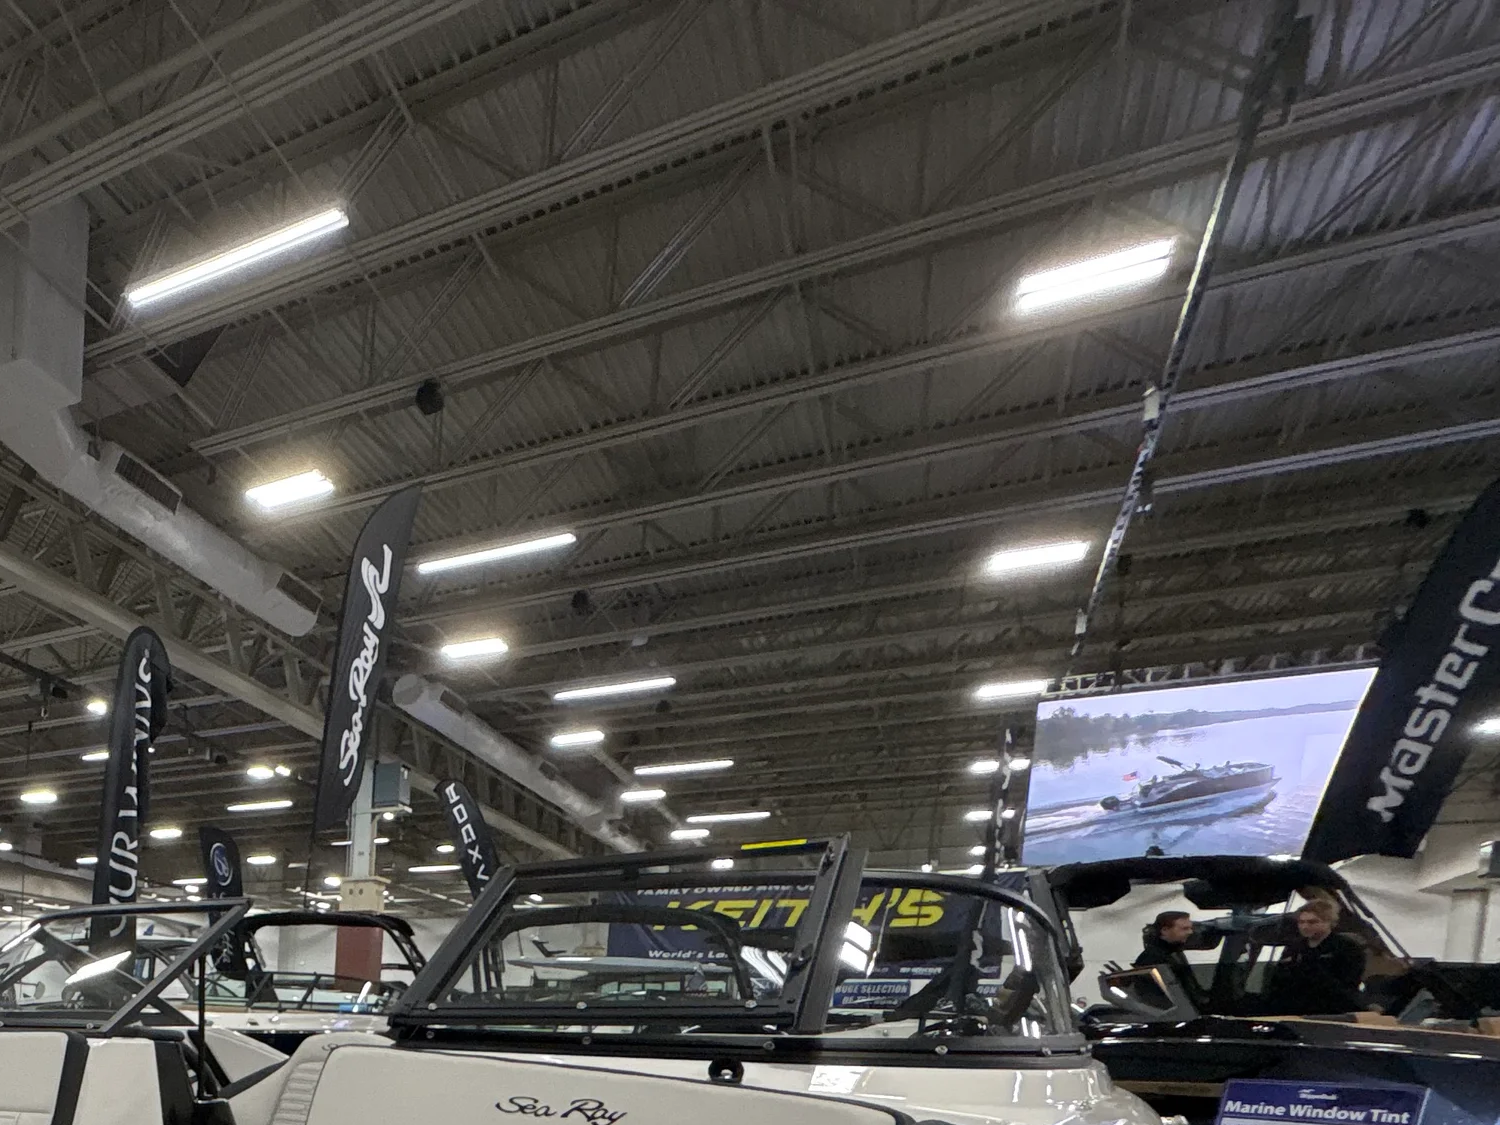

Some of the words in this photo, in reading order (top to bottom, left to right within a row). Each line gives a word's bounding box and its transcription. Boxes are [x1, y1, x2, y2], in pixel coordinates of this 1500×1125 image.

[349, 622, 379, 708] Ray
[1366, 557, 1500, 823] MasterC
[339, 703, 363, 787] Sea
[495, 1096, 557, 1118] Sea
[1224, 1100, 1286, 1116] Marine
[1289, 1104, 1367, 1122] Window
[1369, 1108, 1411, 1124] Tint
